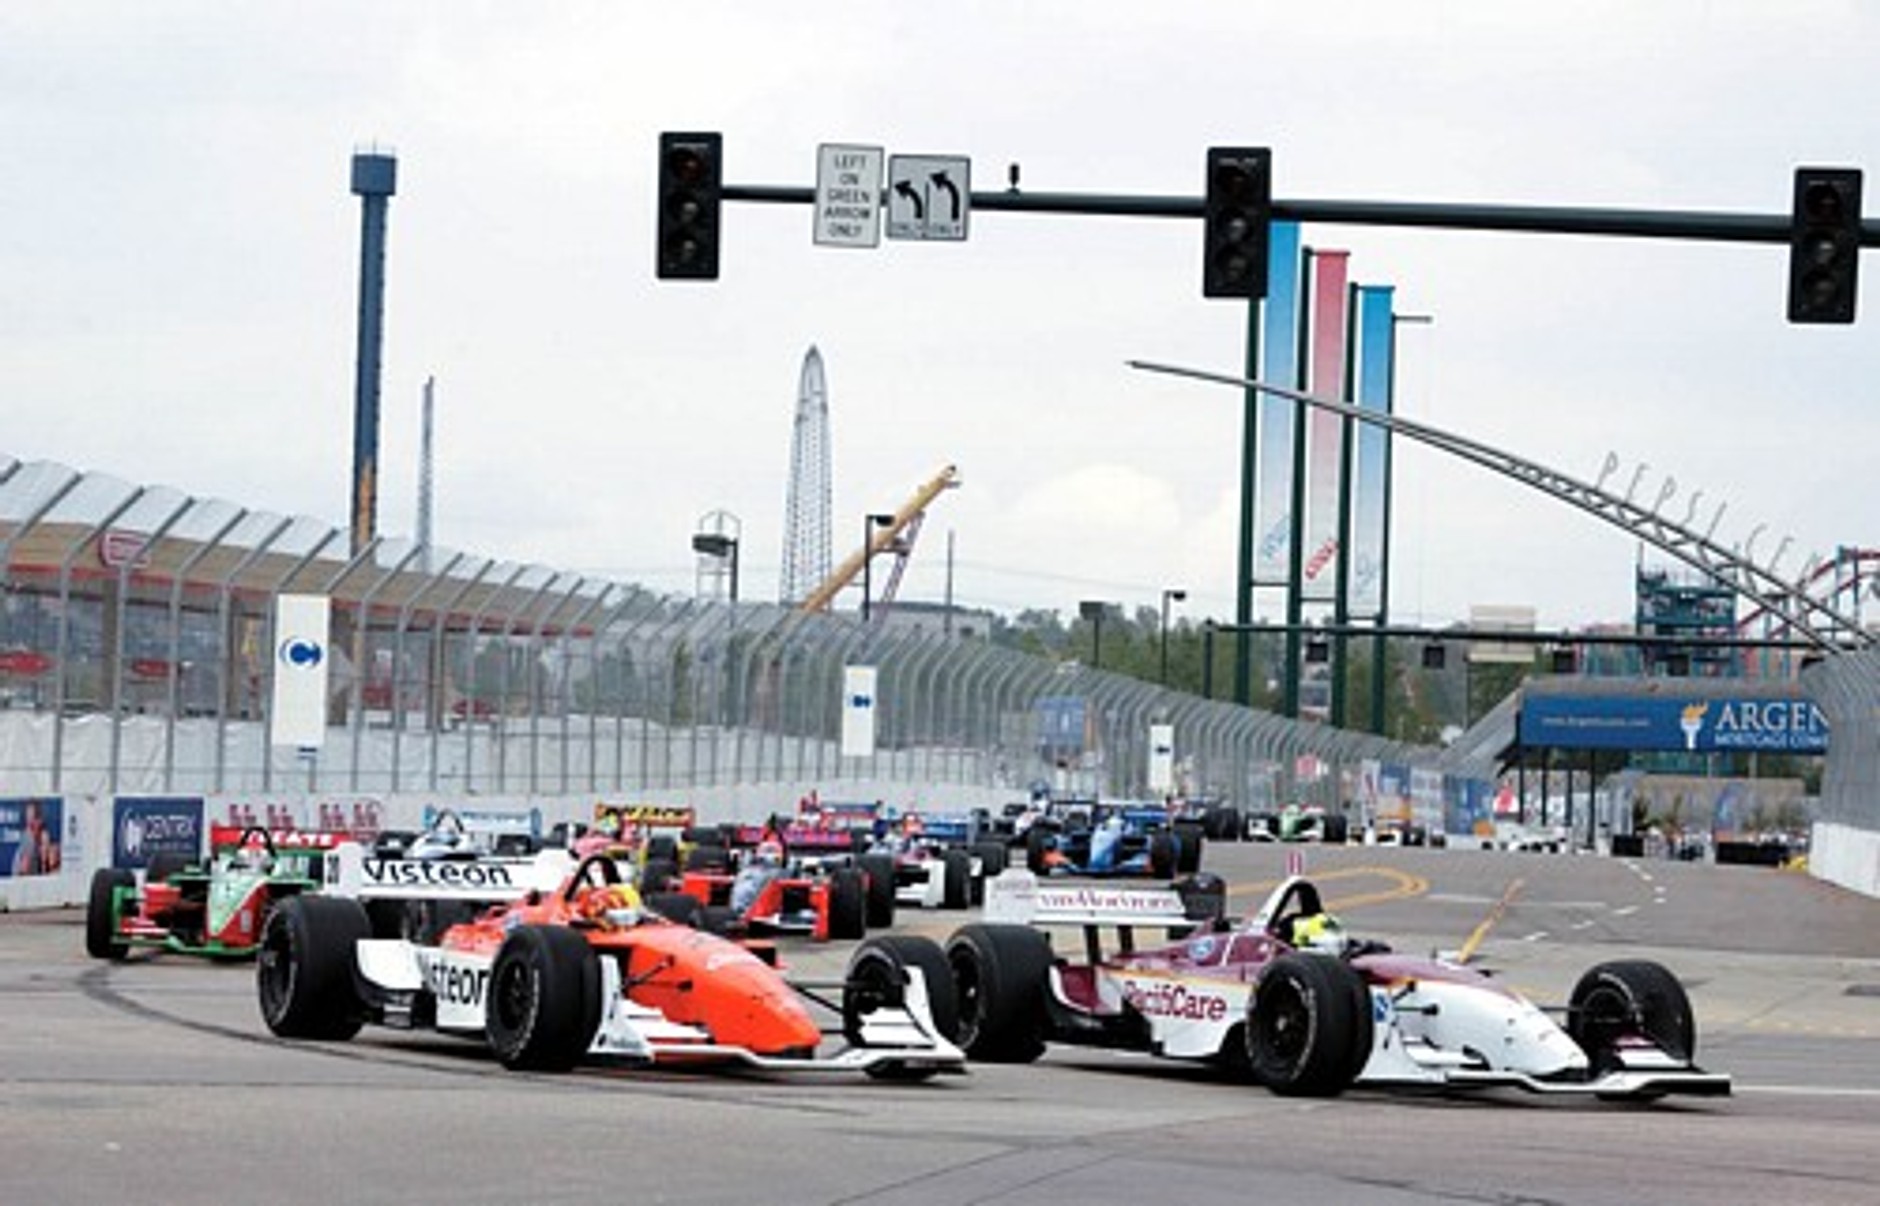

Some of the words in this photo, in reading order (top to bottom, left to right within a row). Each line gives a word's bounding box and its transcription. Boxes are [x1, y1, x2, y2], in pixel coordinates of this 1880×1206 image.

[834, 154, 867, 169] LEFT
[839, 173, 860, 186] ON
[827, 188, 870, 204] GREEN
[824, 206, 871, 221] ARROW
[826, 222, 863, 238] ONLY
[362, 856, 513, 887] Visteon
